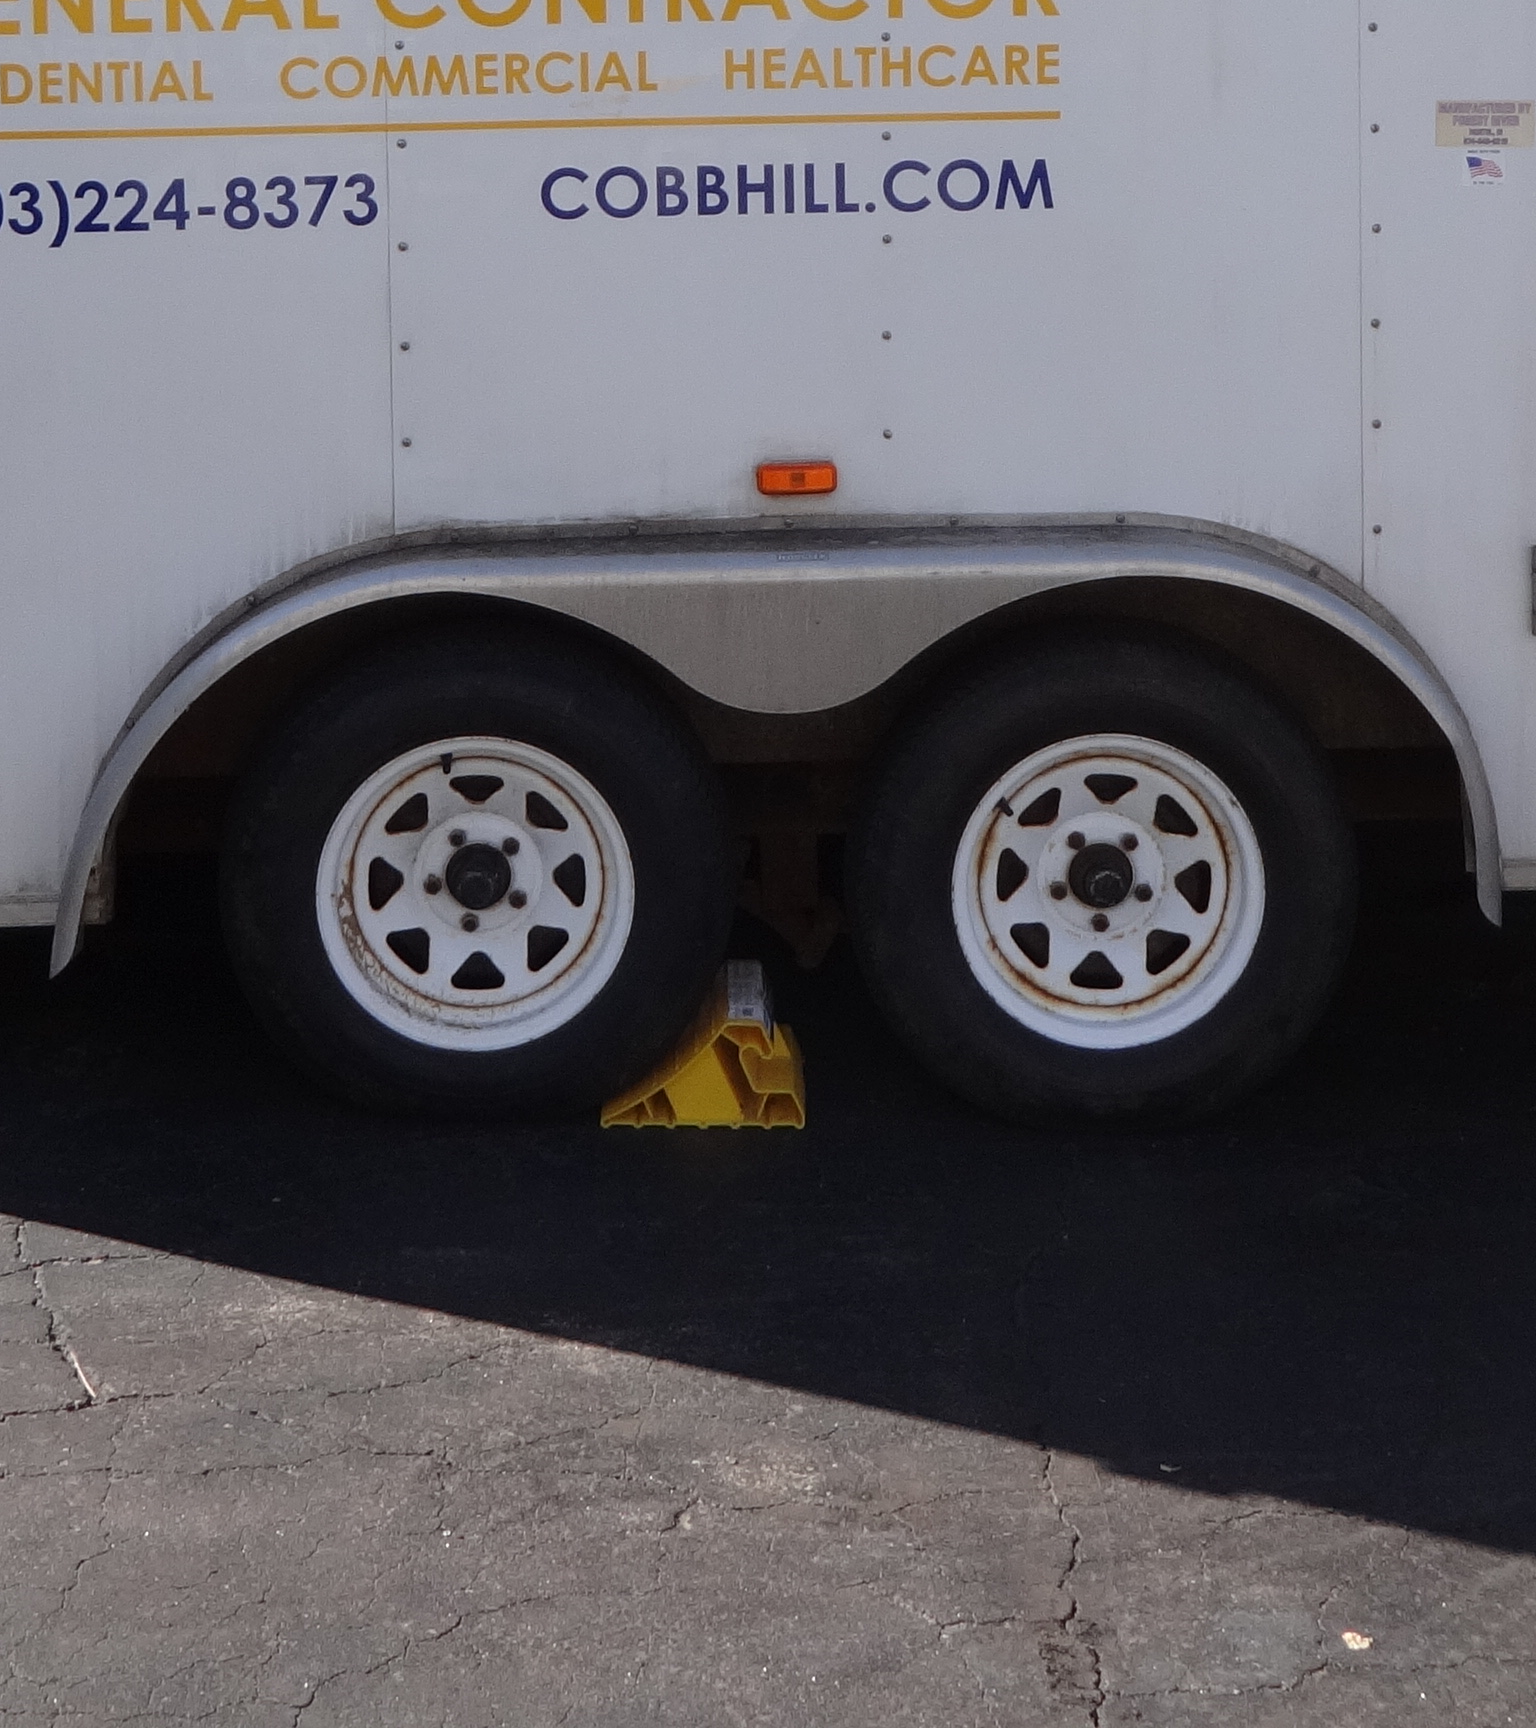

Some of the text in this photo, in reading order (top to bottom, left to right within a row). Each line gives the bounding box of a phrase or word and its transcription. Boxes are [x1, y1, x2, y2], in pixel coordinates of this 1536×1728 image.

[278, 51, 659, 101] COMMERCIAL
[724, 43, 1060, 90] HEALTHCARE
[541, 158, 1053, 219] COBBHILL.COM
